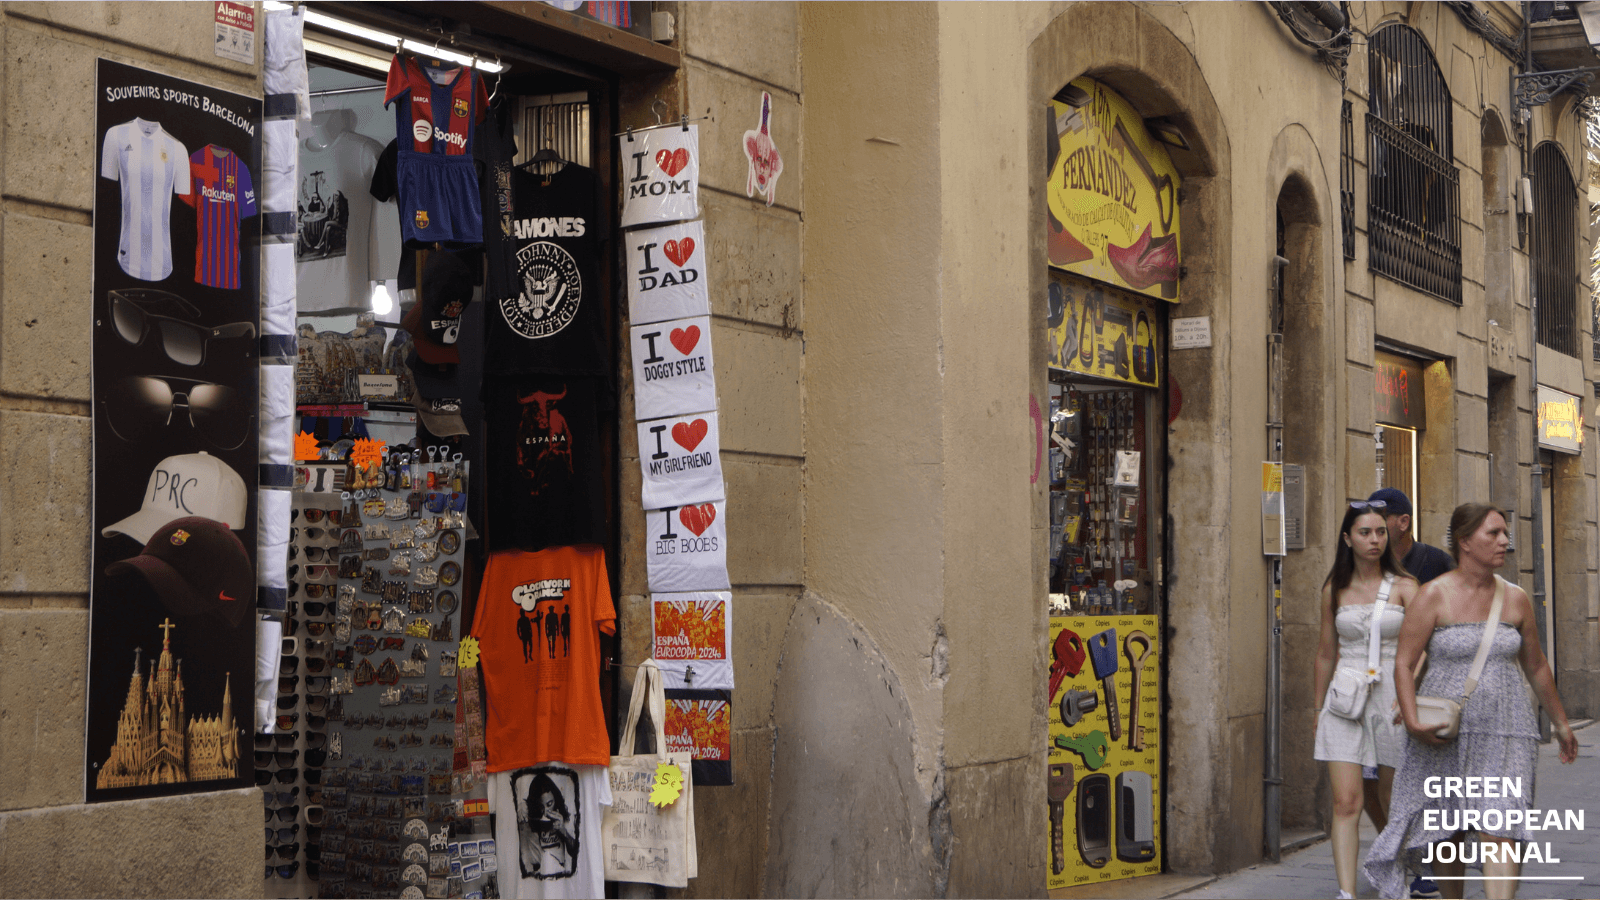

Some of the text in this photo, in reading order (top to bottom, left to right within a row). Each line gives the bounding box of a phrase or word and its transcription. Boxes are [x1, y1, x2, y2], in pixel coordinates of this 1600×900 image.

[217, 2, 253, 22] Alarma
[434, 126, 467, 149] Spotify
[631, 151, 649, 183] I
[202, 185, 236, 203] Rakuten
[630, 179, 691, 200] MOM
[514, 217, 586, 239] AMONES
[517, 243, 569, 266] JOHNNY
[637, 242, 660, 275] I
[638, 268, 699, 292] DAD
[641, 331, 664, 364] I
[644, 356, 706, 382] DOGGY STYLE
[650, 425, 669, 460] I
[649, 452, 712, 476] MY GIRLFRIEND
[152, 469, 198, 515] PRC
[659, 506, 678, 540] I
[656, 537, 719, 555] BIG BOOBS
[511, 578, 571, 606] CLOCKWORK
[1073, 620, 1085, 628] Copy
[1142, 618, 1154, 626] Copy
[655, 646, 718, 658] EUROCOPA 2024
[1144, 664, 1155, 672] Copy
[1144, 711, 1155, 719] Copy
[665, 732, 693, 745] SPAÑA
[701, 747, 721, 759] 2024
[1144, 757, 1155, 766] Copy
